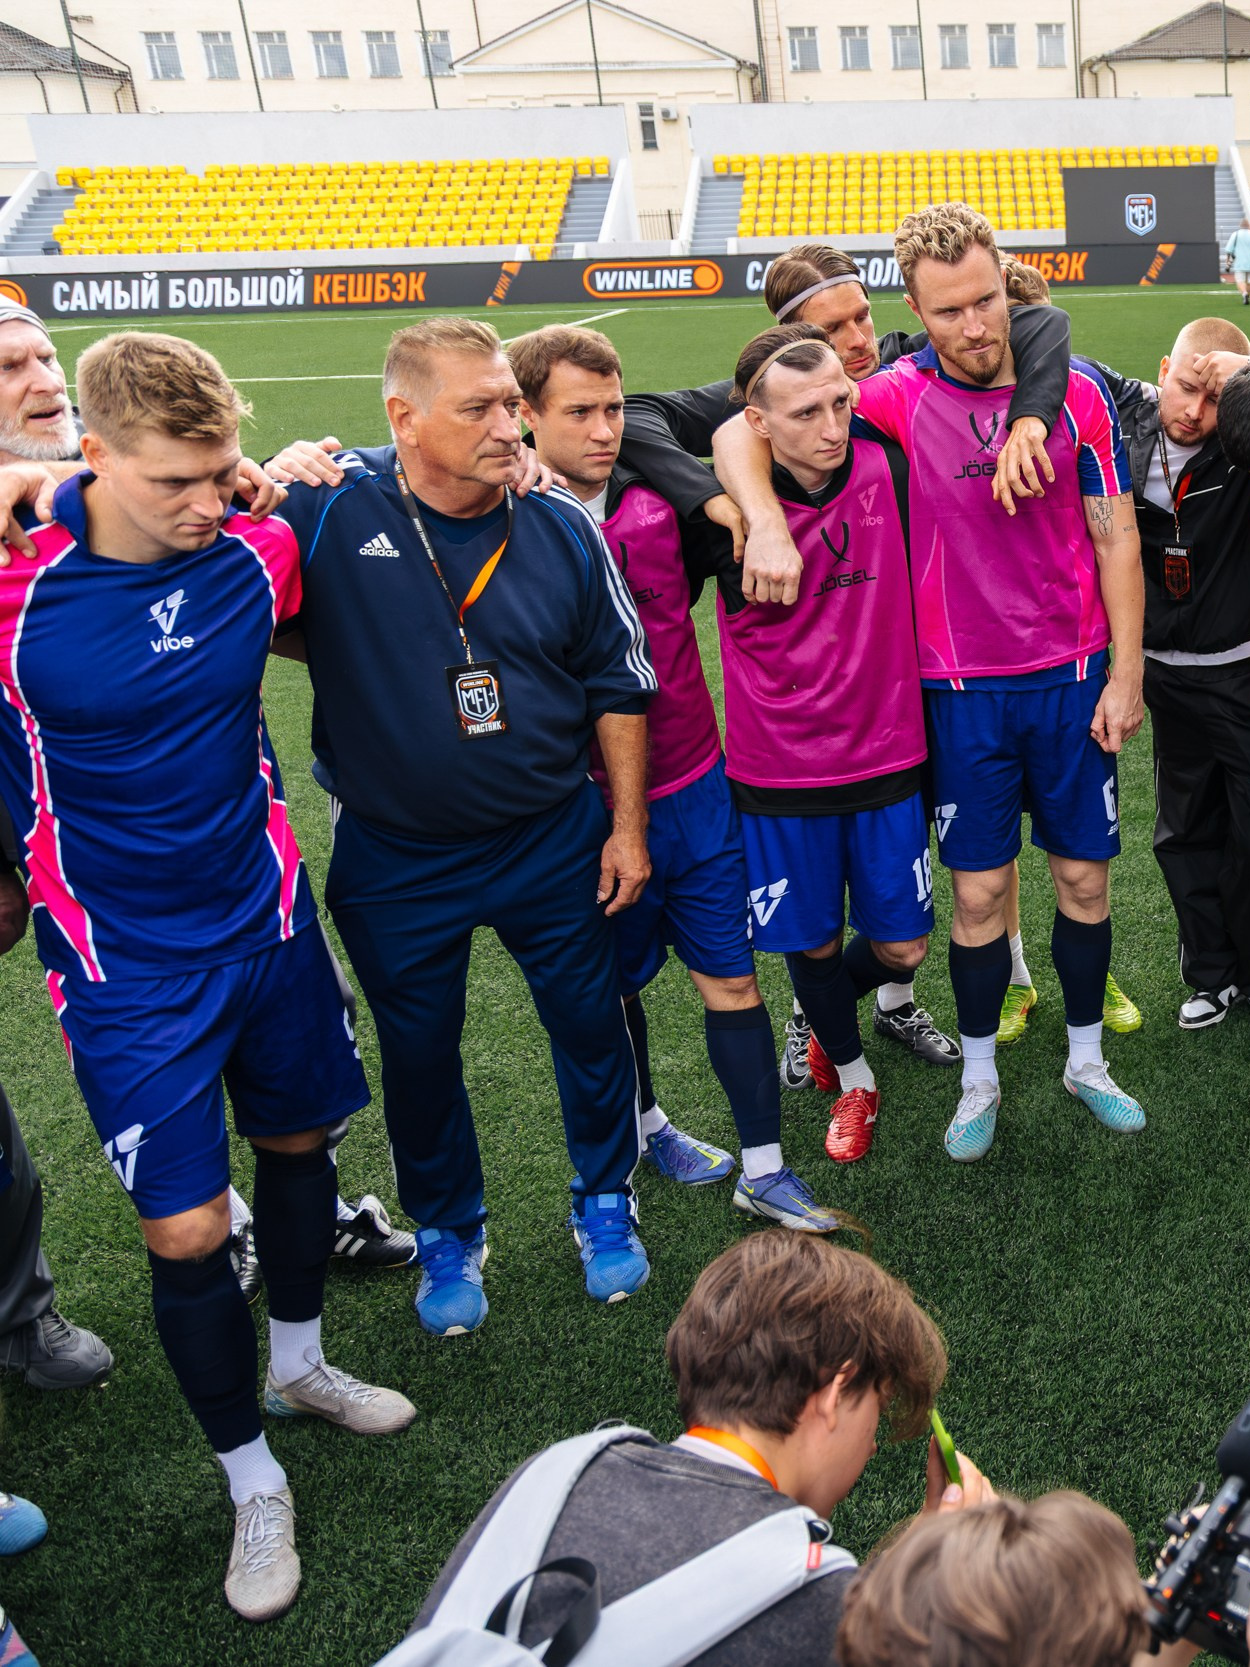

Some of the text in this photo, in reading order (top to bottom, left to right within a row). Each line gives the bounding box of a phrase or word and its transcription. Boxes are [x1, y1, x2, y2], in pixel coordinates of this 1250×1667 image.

[594, 268, 693, 290] WINLINE
[53, 268, 427, 312] САМЫЙ БОЛЬШОЙ КЕШБЭК
[954, 460, 996, 479] JÖG
[636, 510, 667, 527] vibe
[858, 514, 885, 527] vibe
[359, 546, 400, 558] adidas
[813, 568, 878, 597] JÖGEL
[150, 635, 195, 653] vibe
[461, 687, 496, 719] MFL
[467, 720, 502, 735] УЧАСТНИК
[912, 847, 932, 902] 18
